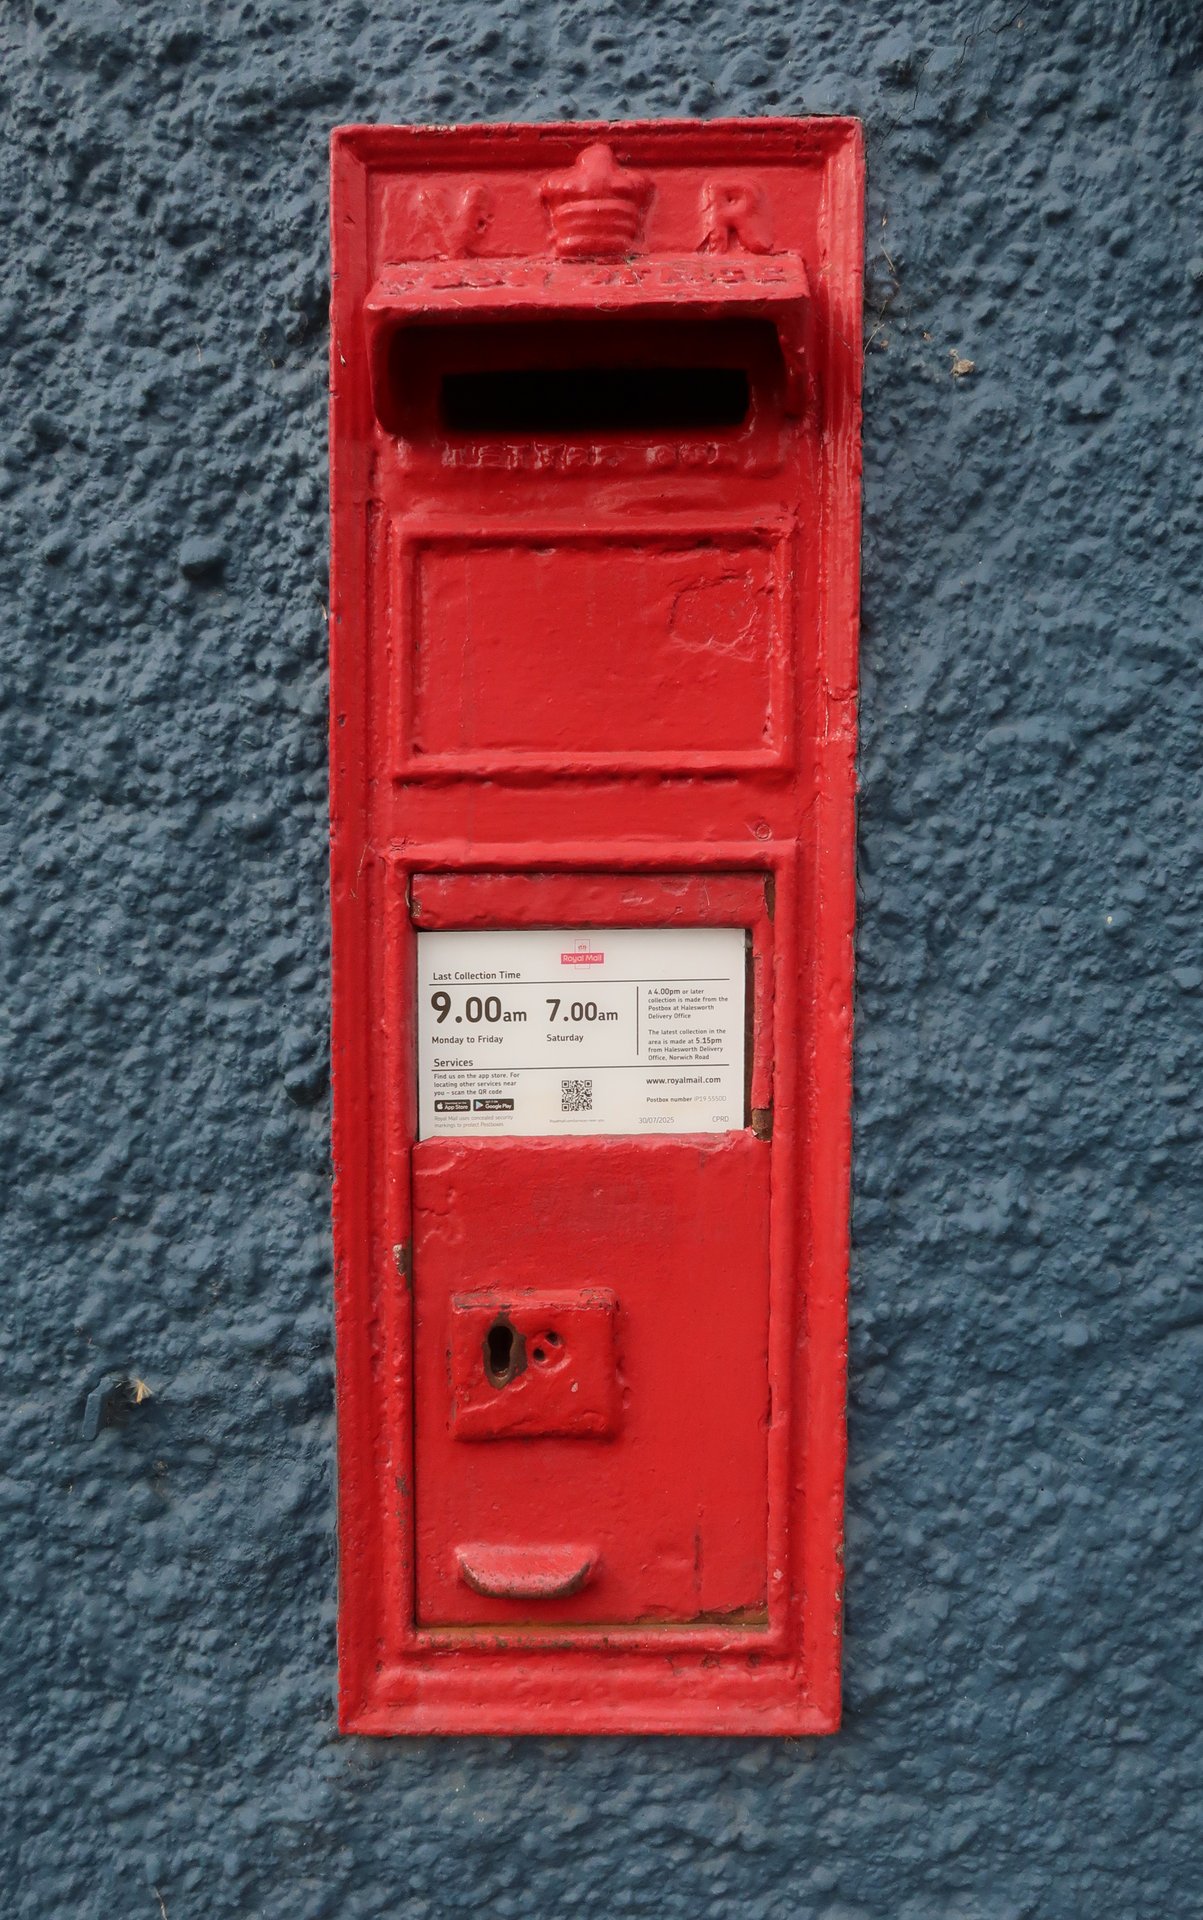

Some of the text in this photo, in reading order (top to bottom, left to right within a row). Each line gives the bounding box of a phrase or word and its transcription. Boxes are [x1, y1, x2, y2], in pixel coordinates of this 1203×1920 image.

[697, 178, 775, 255] R
[562, 954, 584, 962] Royal
[432, 970, 521, 980] Last Collection Time
[654, 988, 680, 996] 4.00pm
[430, 991, 527, 1024] 9.00am
[546, 999, 618, 1022] 7.00am
[432, 1036, 464, 1045] Monday
[478, 1035, 504, 1044] Friday
[546, 1034, 584, 1042] Saturday
[434, 1058, 474, 1067] Services
[646, 1076, 721, 1085] www.royalmail.com
